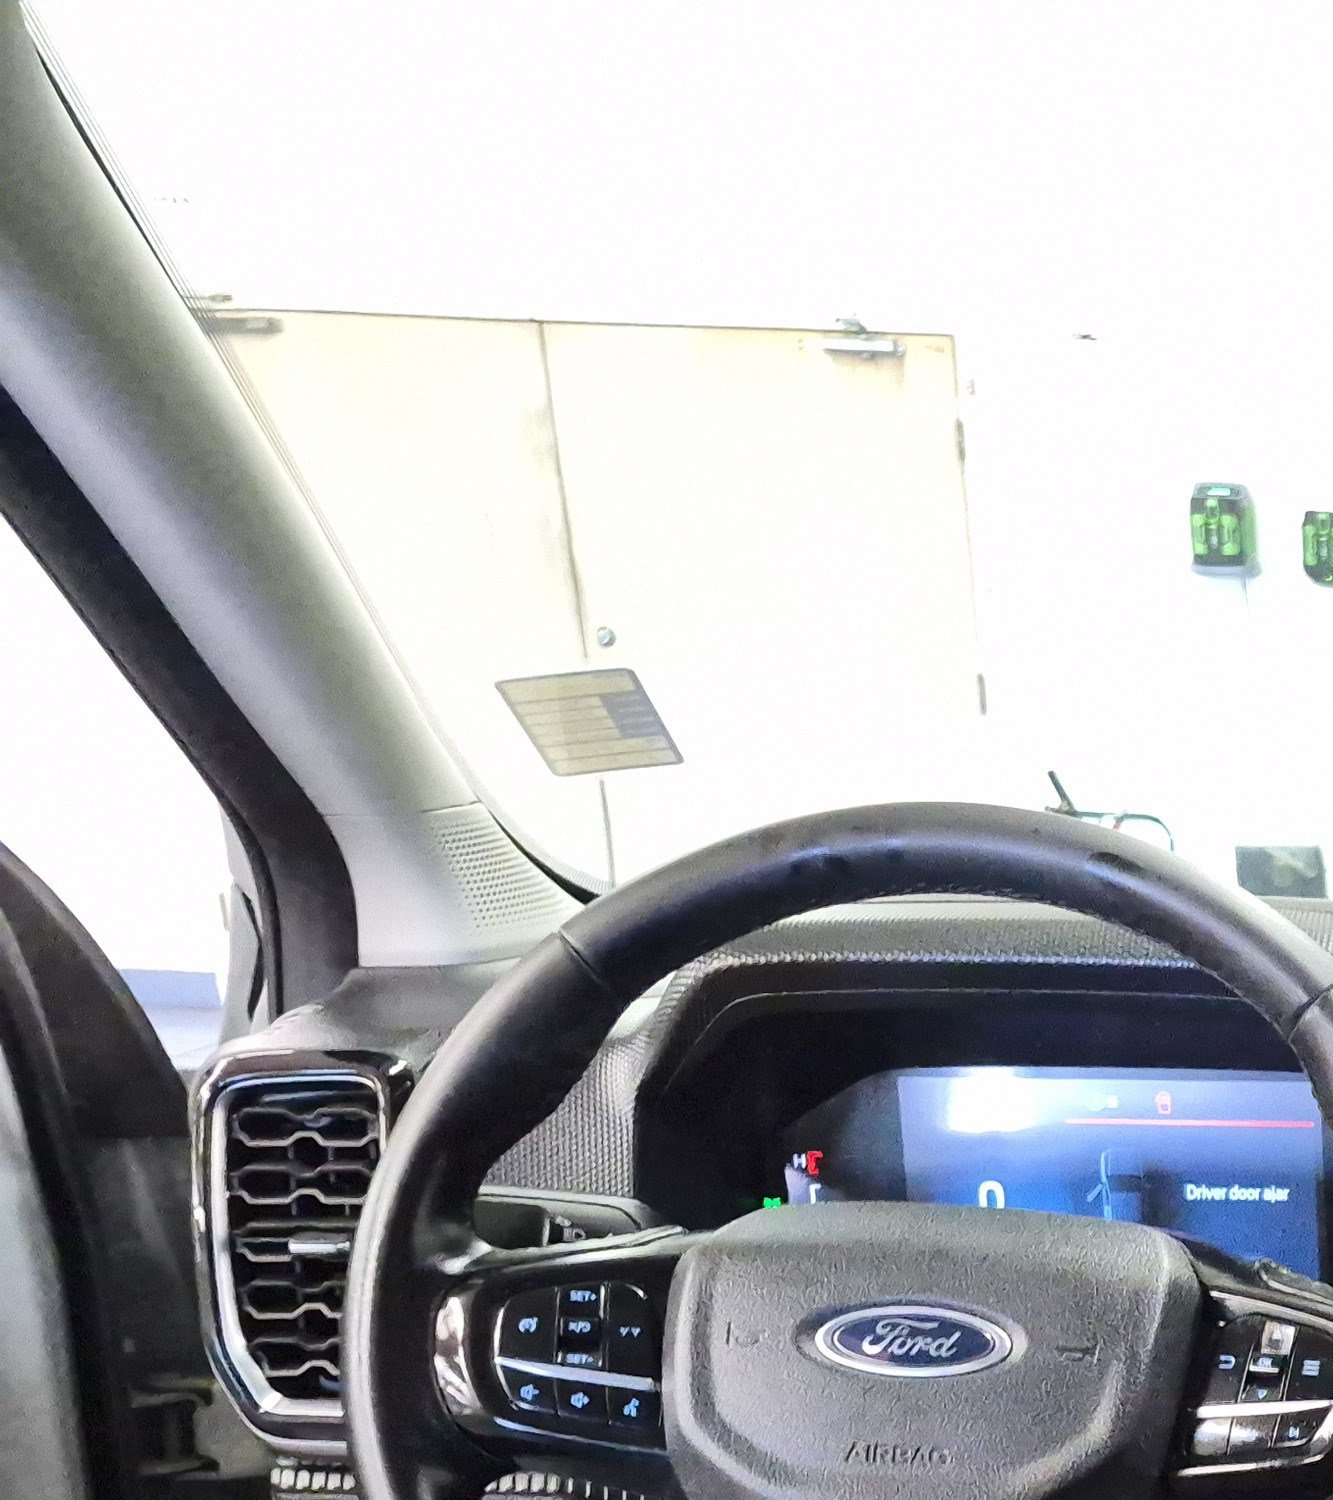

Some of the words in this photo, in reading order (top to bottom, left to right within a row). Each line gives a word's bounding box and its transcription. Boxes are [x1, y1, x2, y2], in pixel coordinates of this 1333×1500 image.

[1186, 1184, 1227, 1201] Driver
[1229, 1184, 1261, 1201] door
[1263, 1185, 1290, 1203] ajar
[861, 1318, 962, 1358] Ford
[845, 1439, 958, 1466] AIRBAG
